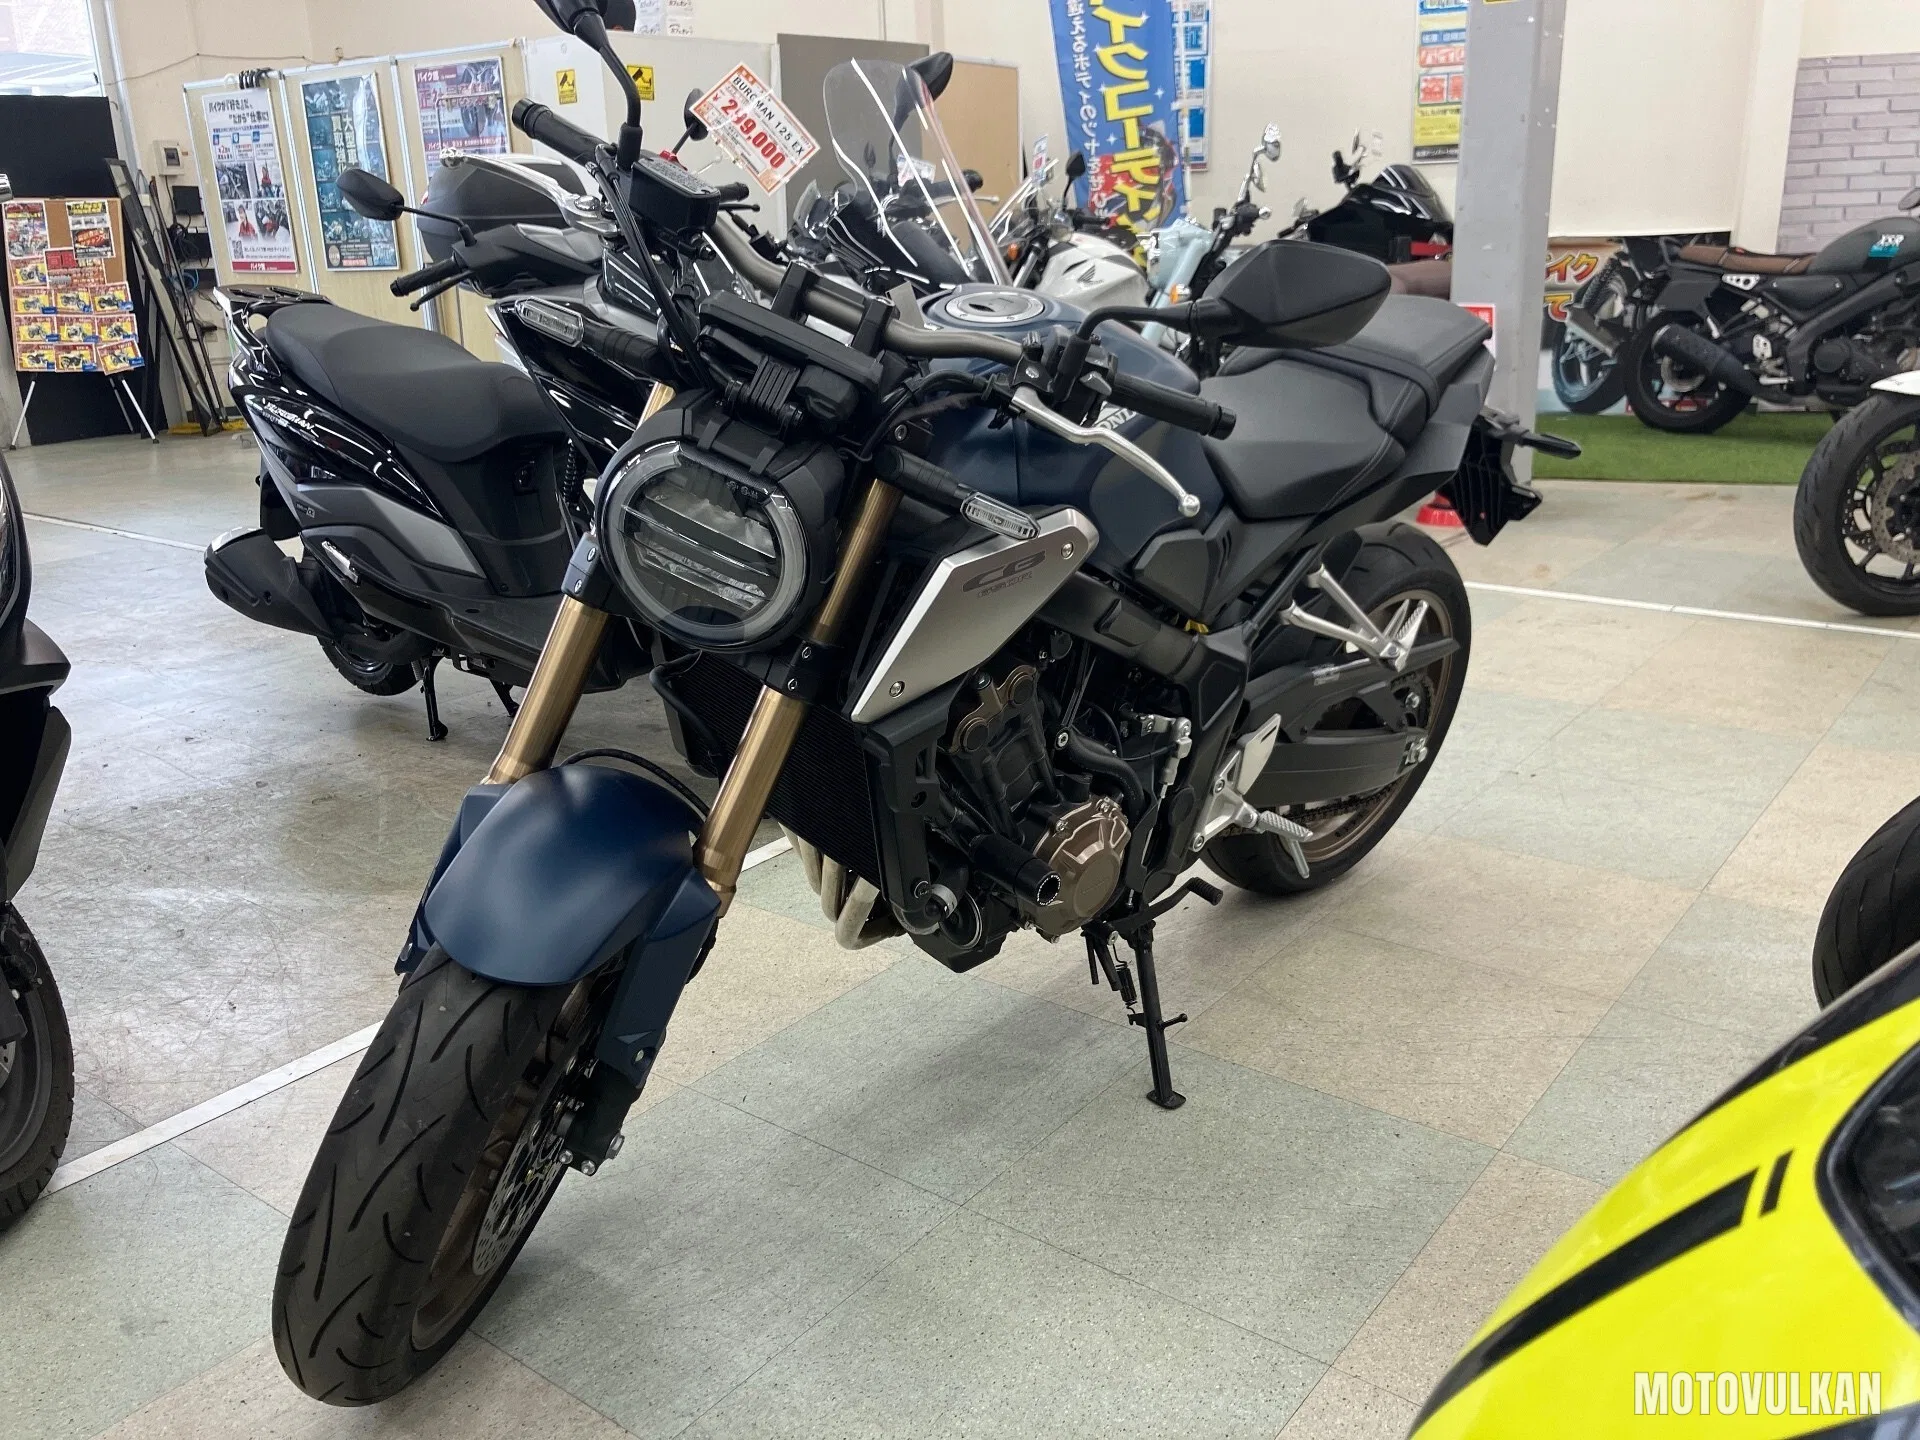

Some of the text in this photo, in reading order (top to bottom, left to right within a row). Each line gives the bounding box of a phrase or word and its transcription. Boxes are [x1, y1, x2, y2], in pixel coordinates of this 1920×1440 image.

[732, 77, 804, 155] BURGMAN 125 EX
[342, 114, 359, 166] 大型車
[1545, 253, 1599, 282] イク
[962, 550, 1046, 593] CB
